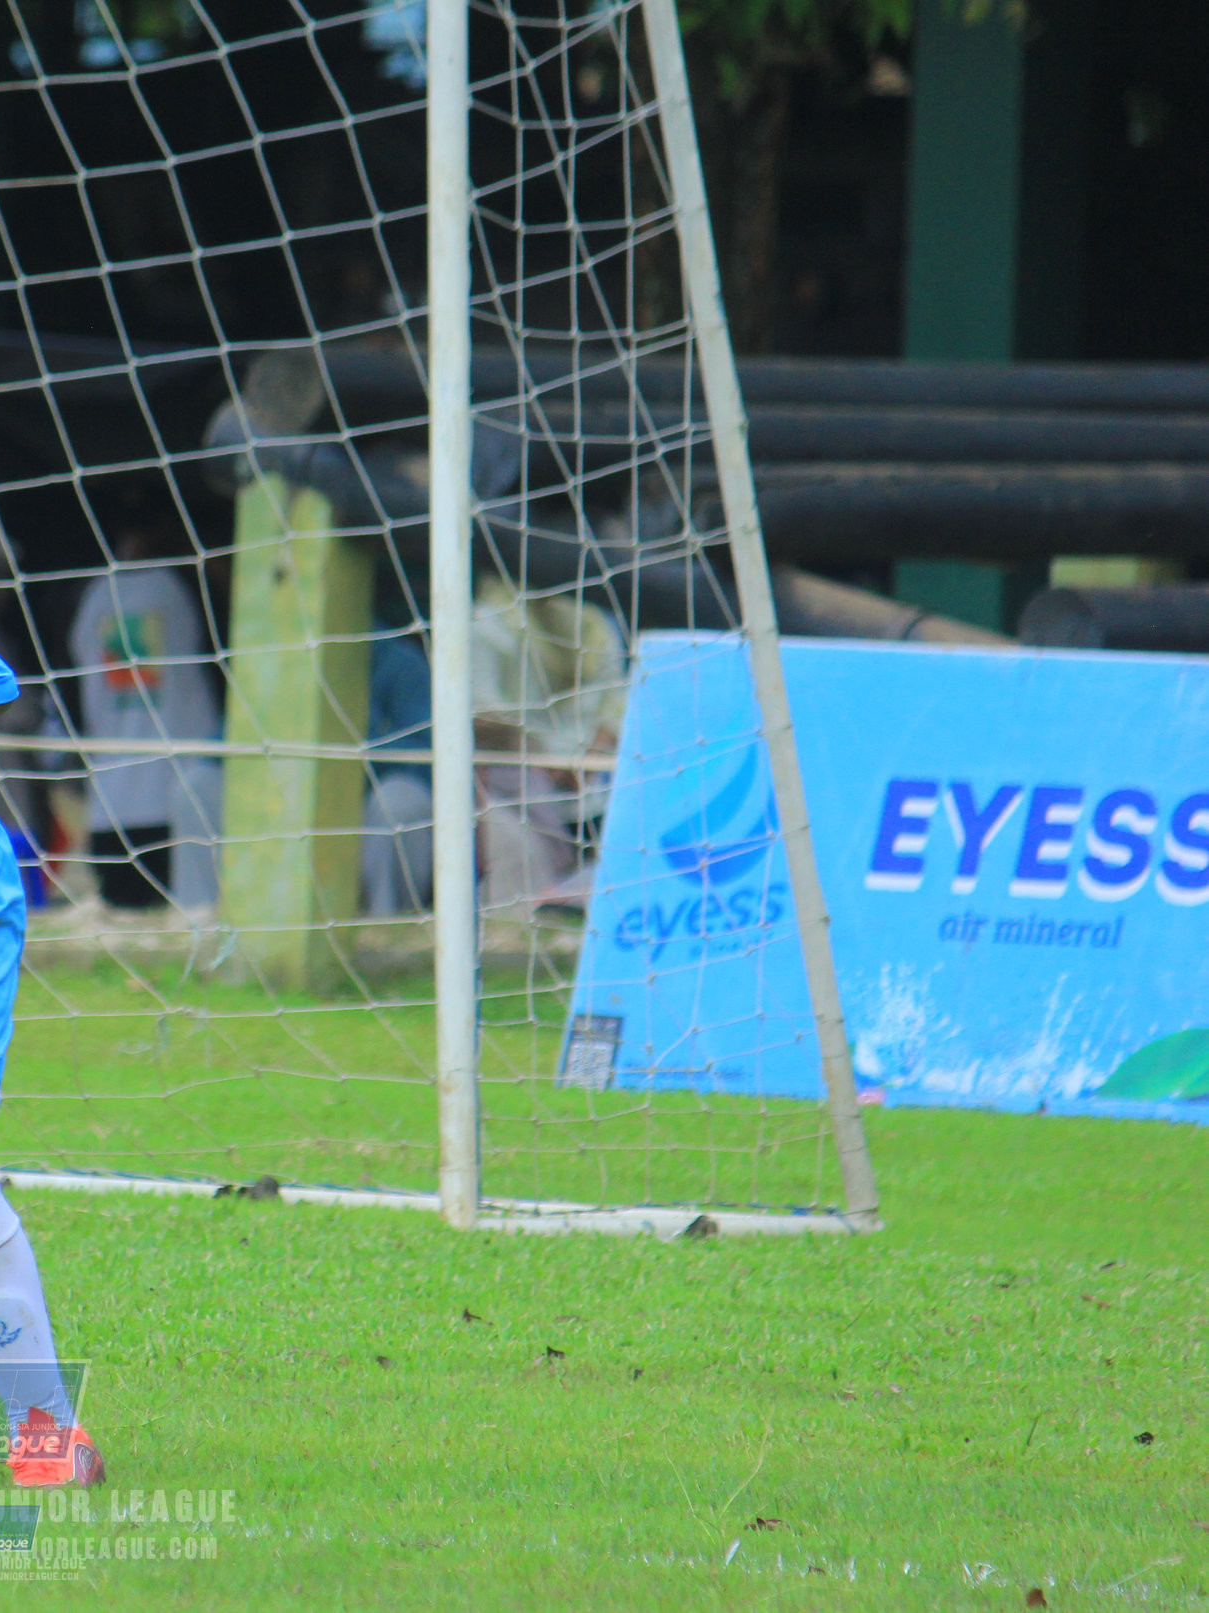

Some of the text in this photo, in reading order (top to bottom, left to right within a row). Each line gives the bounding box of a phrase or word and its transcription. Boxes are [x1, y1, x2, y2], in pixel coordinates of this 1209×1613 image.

[866, 780, 1209, 906] EYESS
[614, 882, 788, 963] eyess
[940, 911, 1124, 948] air mineral
